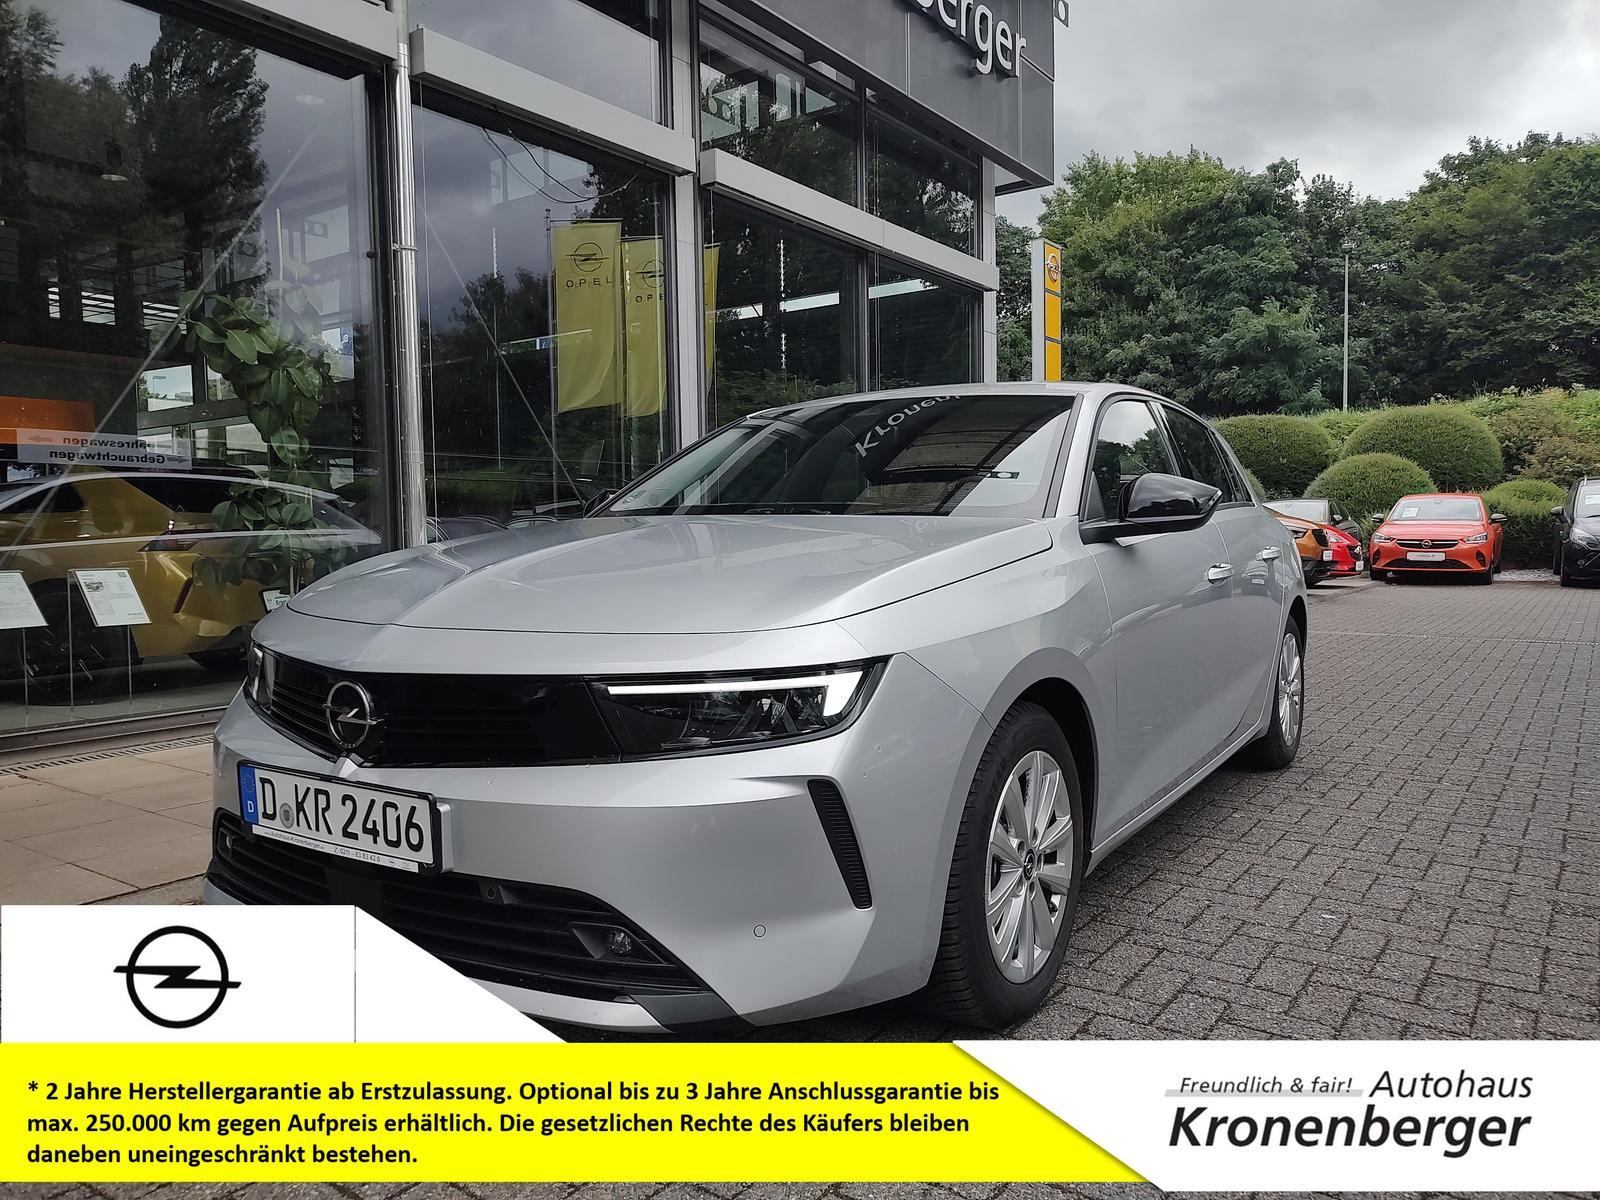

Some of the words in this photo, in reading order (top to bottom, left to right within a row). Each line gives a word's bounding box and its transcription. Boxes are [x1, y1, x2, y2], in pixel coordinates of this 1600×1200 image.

[566, 276, 613, 288] OPEL
[247, 800, 254, 813] D
[259, 776, 277, 820] D
[294, 783, 333, 835] KR
[341, 794, 424, 852] 2406
